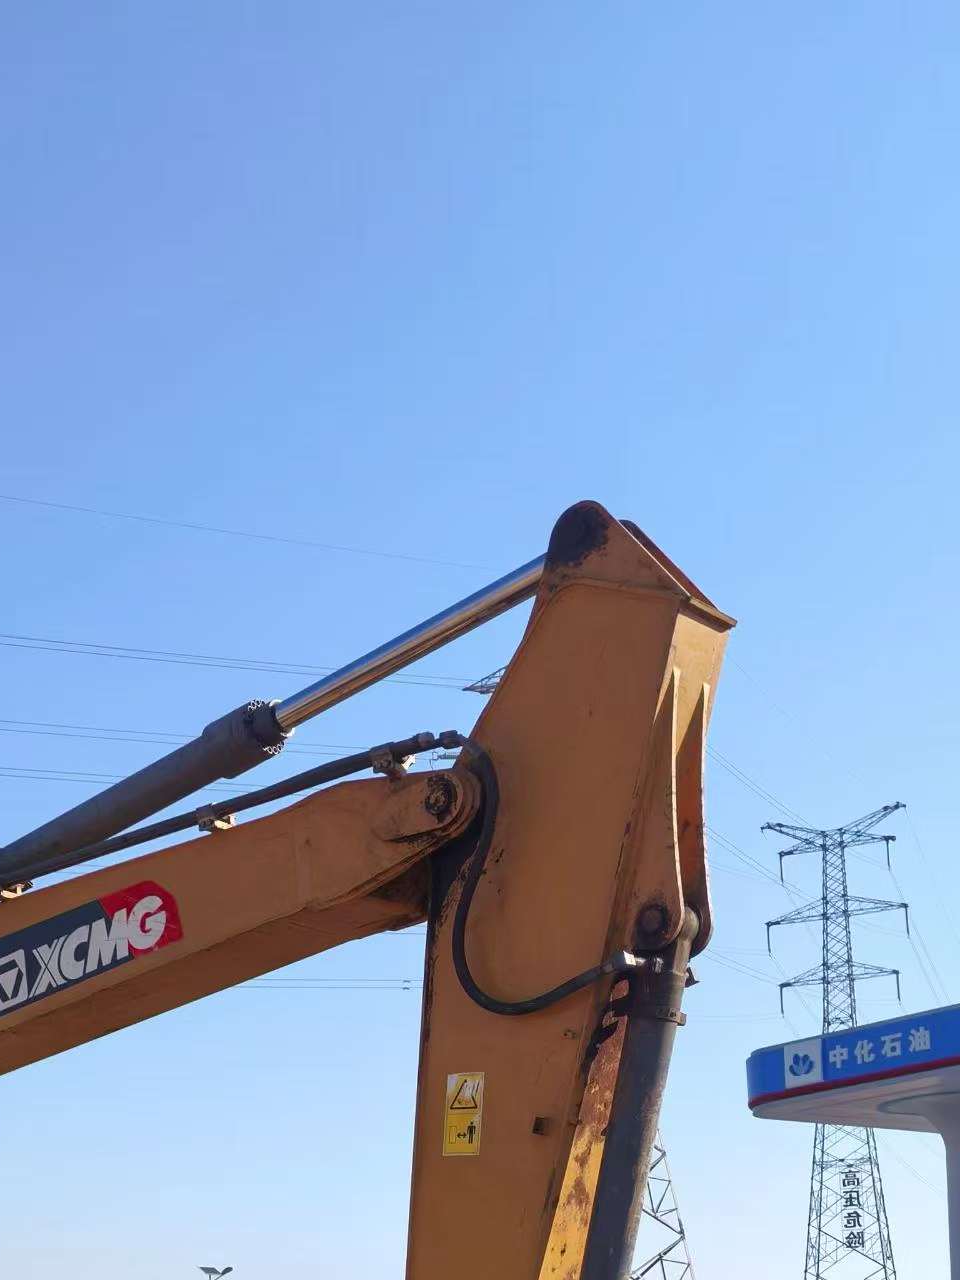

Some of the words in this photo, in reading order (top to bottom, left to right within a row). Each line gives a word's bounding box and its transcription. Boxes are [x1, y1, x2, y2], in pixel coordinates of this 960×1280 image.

[28, 896, 166, 999] XCMG
[829, 1026, 931, 1068] 中化石油
